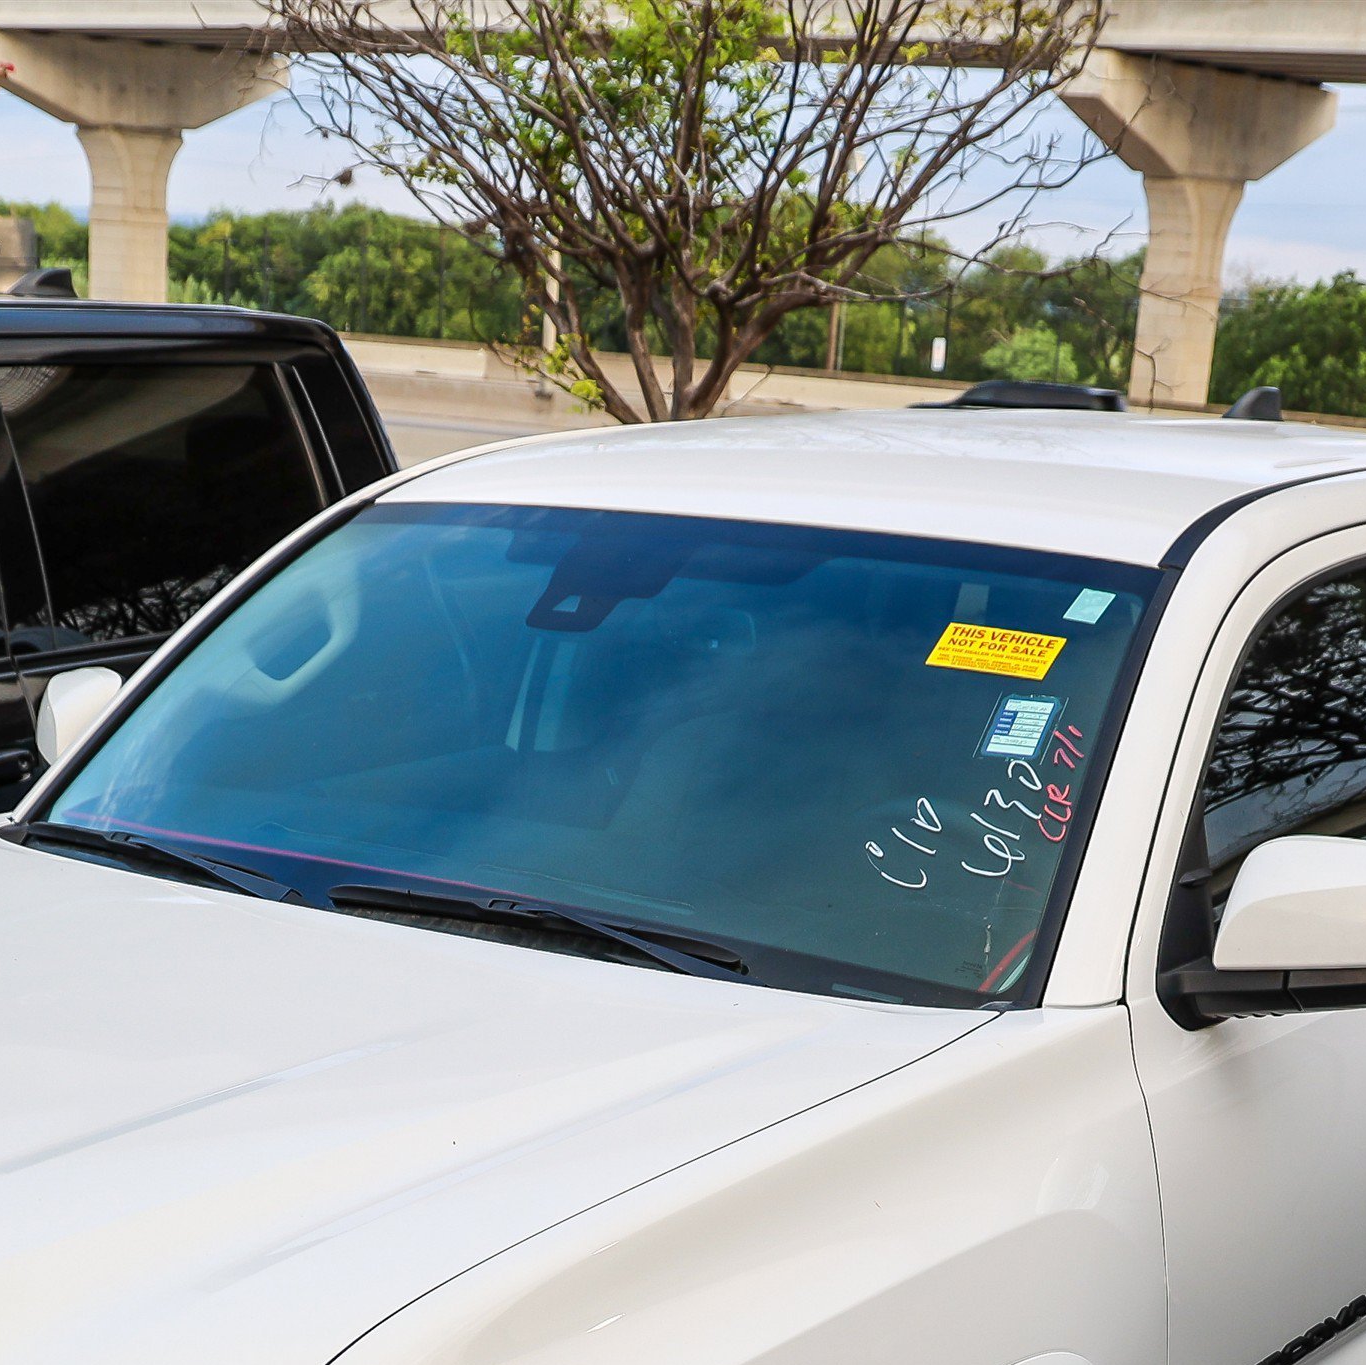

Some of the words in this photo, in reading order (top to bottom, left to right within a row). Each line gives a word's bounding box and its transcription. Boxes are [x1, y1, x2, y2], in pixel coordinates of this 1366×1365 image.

[948, 637, 977, 648] NOT
[979, 641, 1008, 652] FOR
[1011, 646, 1048, 658] SALE
[952, 626, 987, 639] THIS
[991, 631, 1059, 650] VEHICLE
